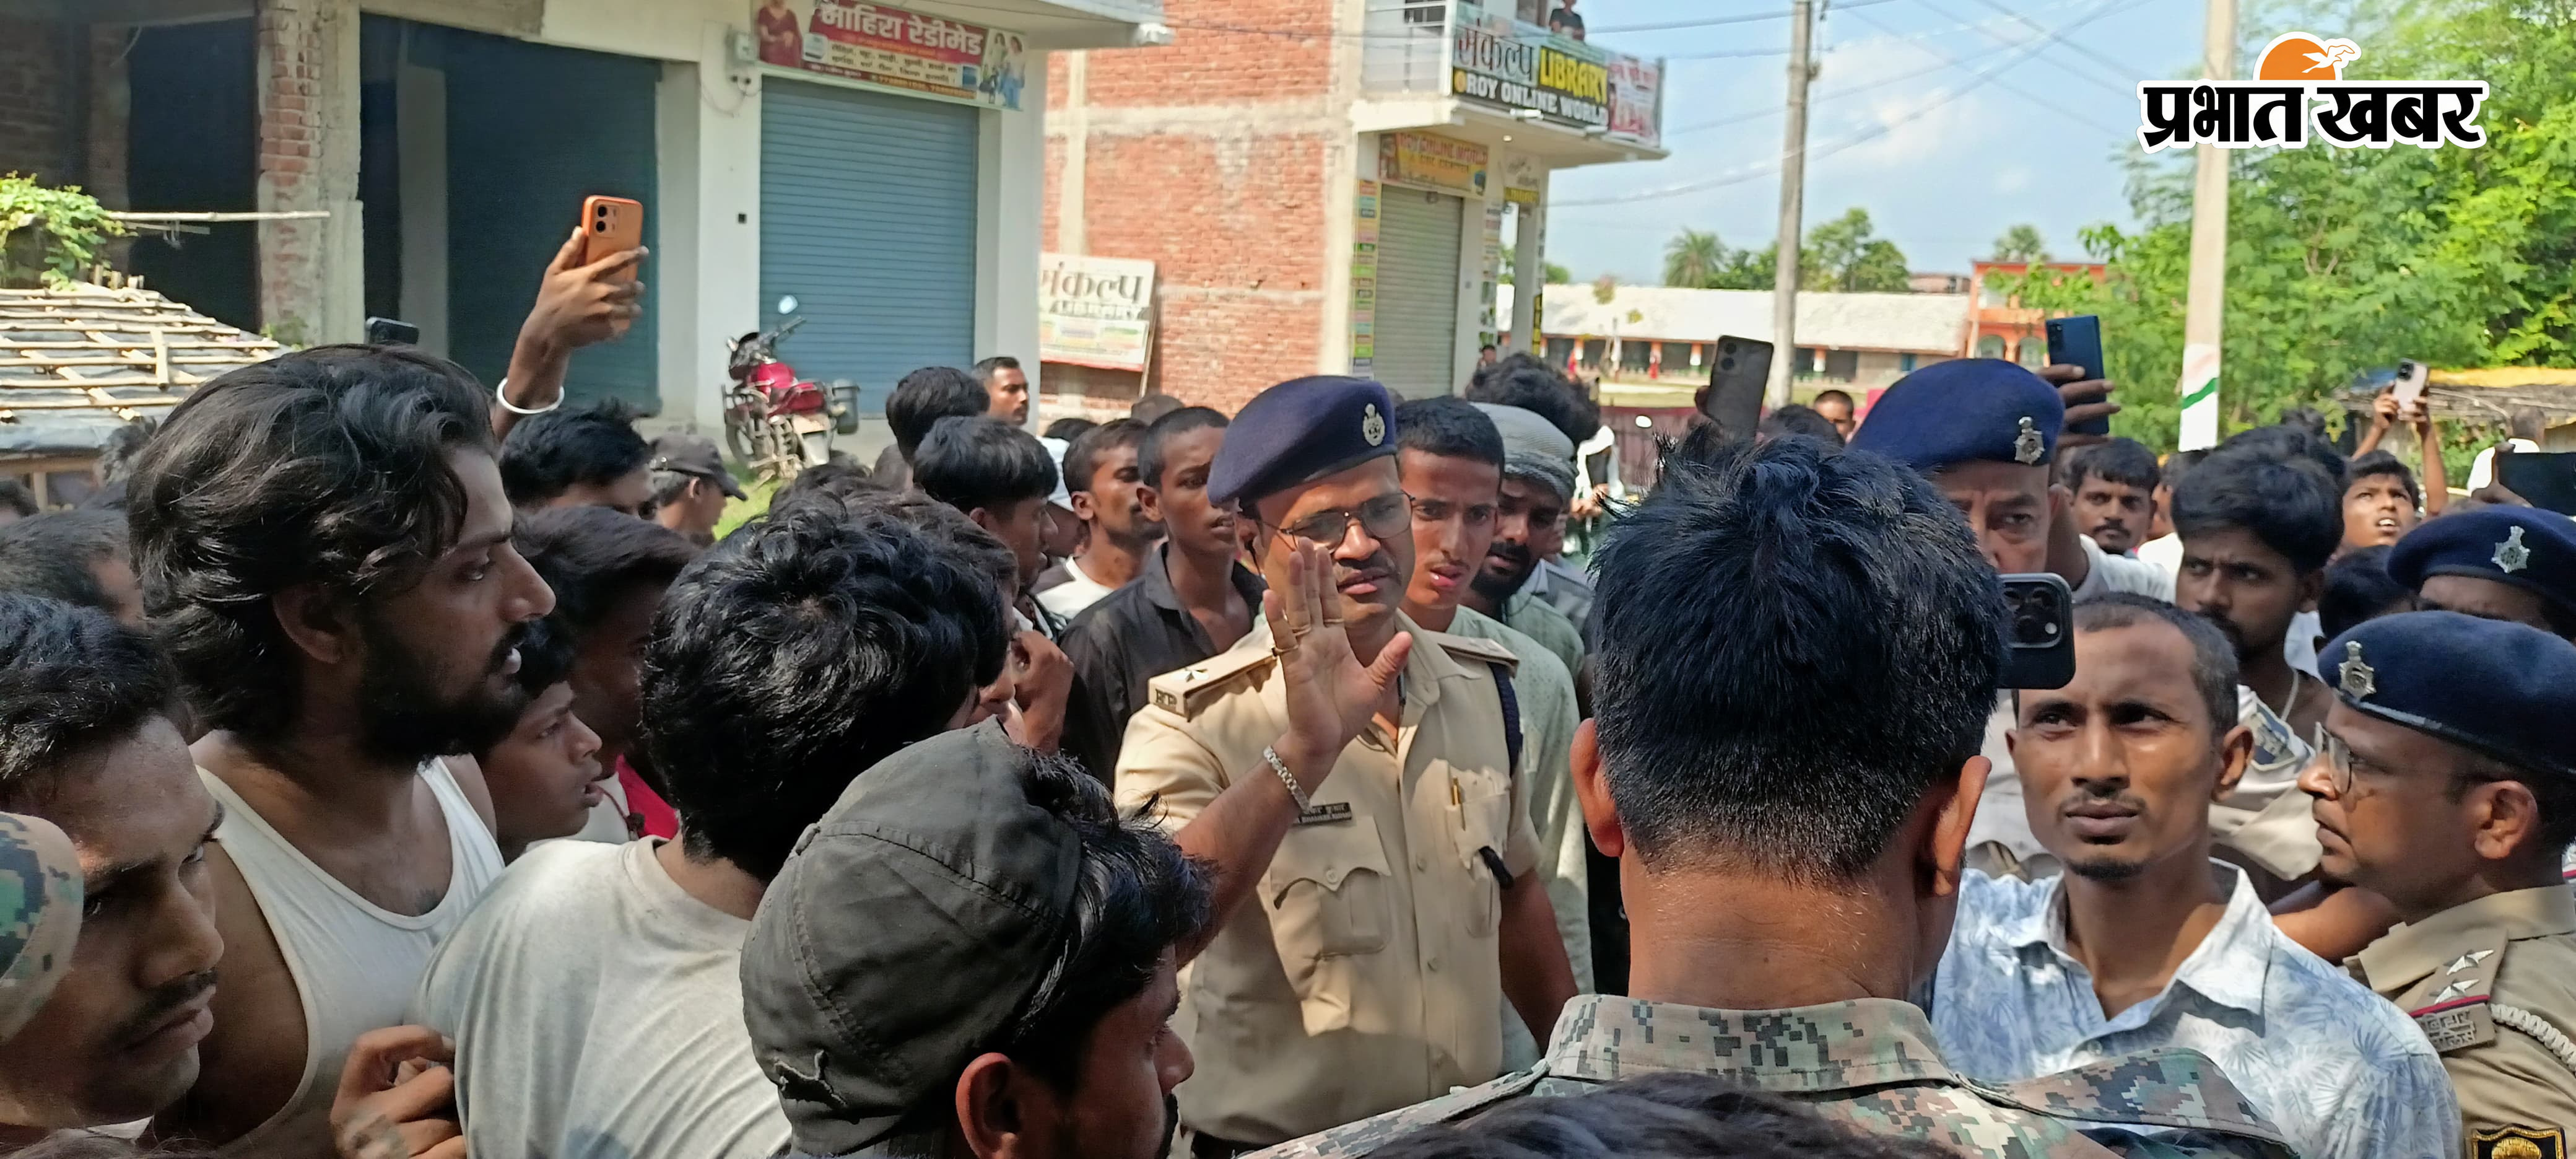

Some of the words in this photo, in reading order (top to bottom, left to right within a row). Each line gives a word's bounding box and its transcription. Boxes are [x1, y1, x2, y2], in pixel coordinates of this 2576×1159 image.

[907, 14, 984, 55] रेडीमेड
[1466, 72, 1499, 100] ROY
[1500, 82, 1558, 113] ONLINE
[1559, 95, 1609, 126] WORLD
[1539, 46, 1609, 105] LIBRARY
